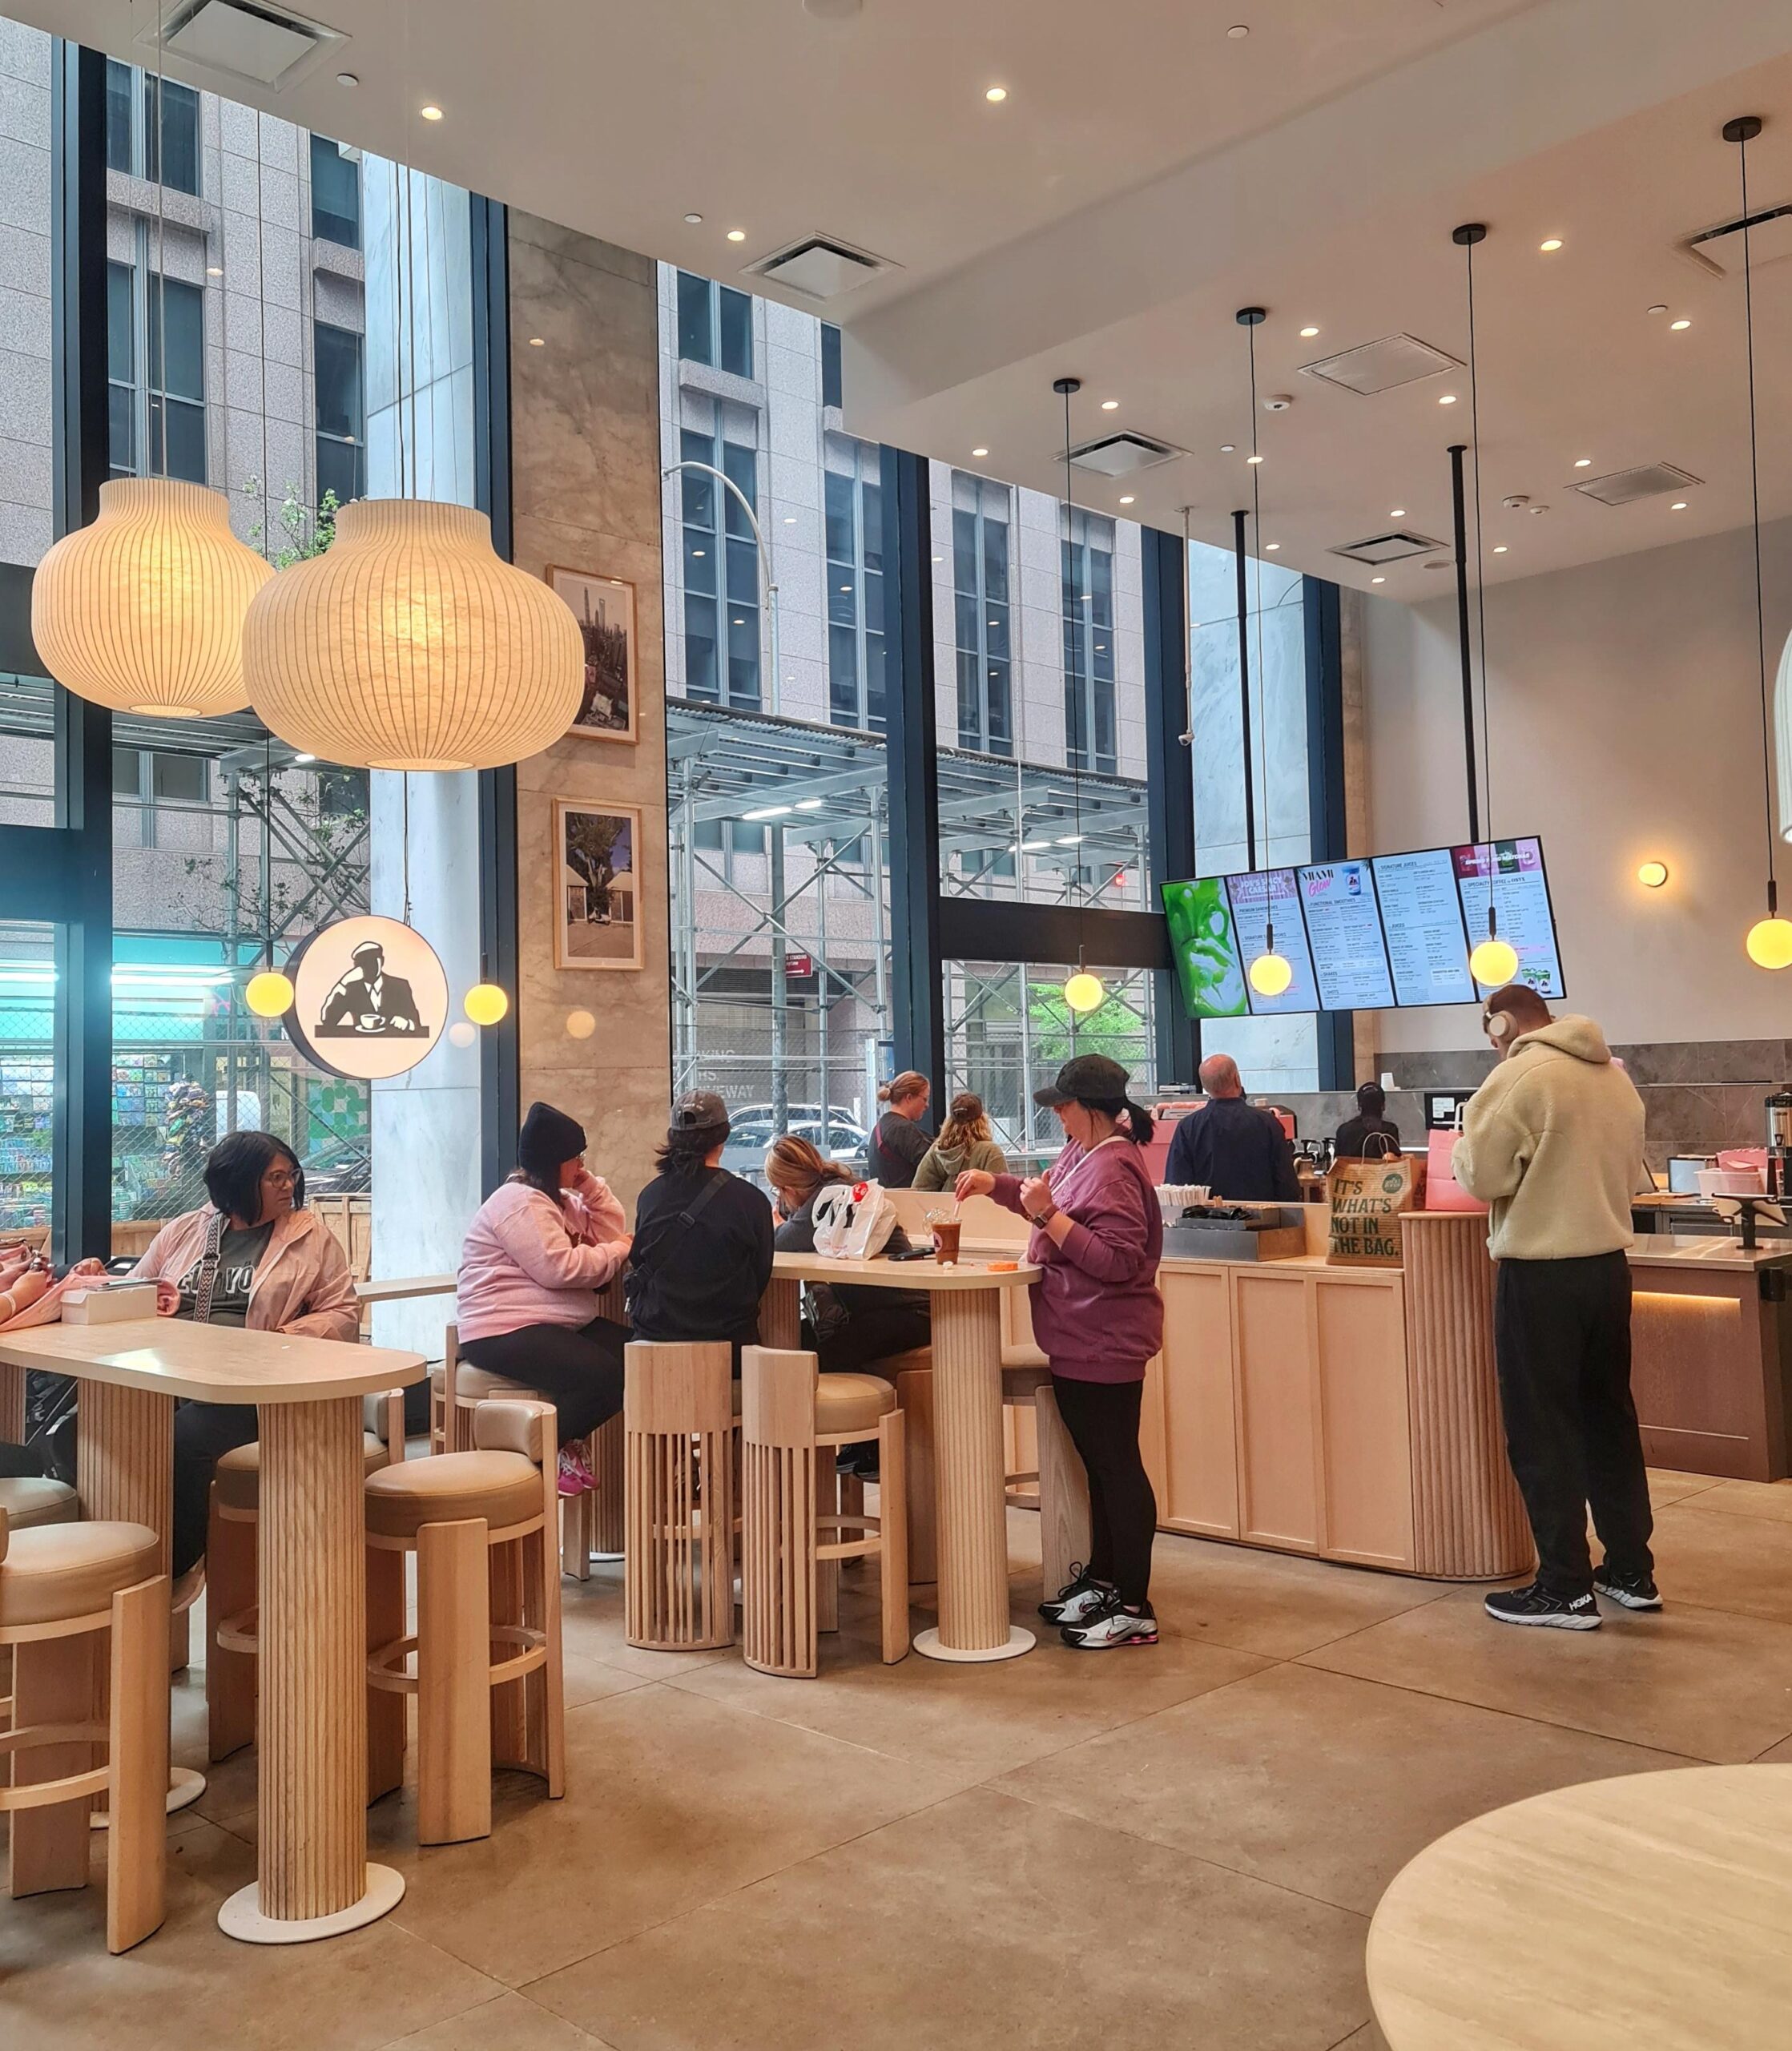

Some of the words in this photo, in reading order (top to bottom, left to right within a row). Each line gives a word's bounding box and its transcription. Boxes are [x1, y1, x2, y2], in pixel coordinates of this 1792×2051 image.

[1303, 869, 1334, 881] MIAMI
[1334, 1179, 1363, 1195] IT'S
[1332, 1197, 1391, 1214] WHAT'S
[1331, 1216, 1359, 1234] NOT
[1363, 1217, 1378, 1235] IN
[1330, 1235, 1361, 1255] THE
[1364, 1237, 1399, 1257] BAG.
[1569, 1594, 1593, 1611] HOKA
